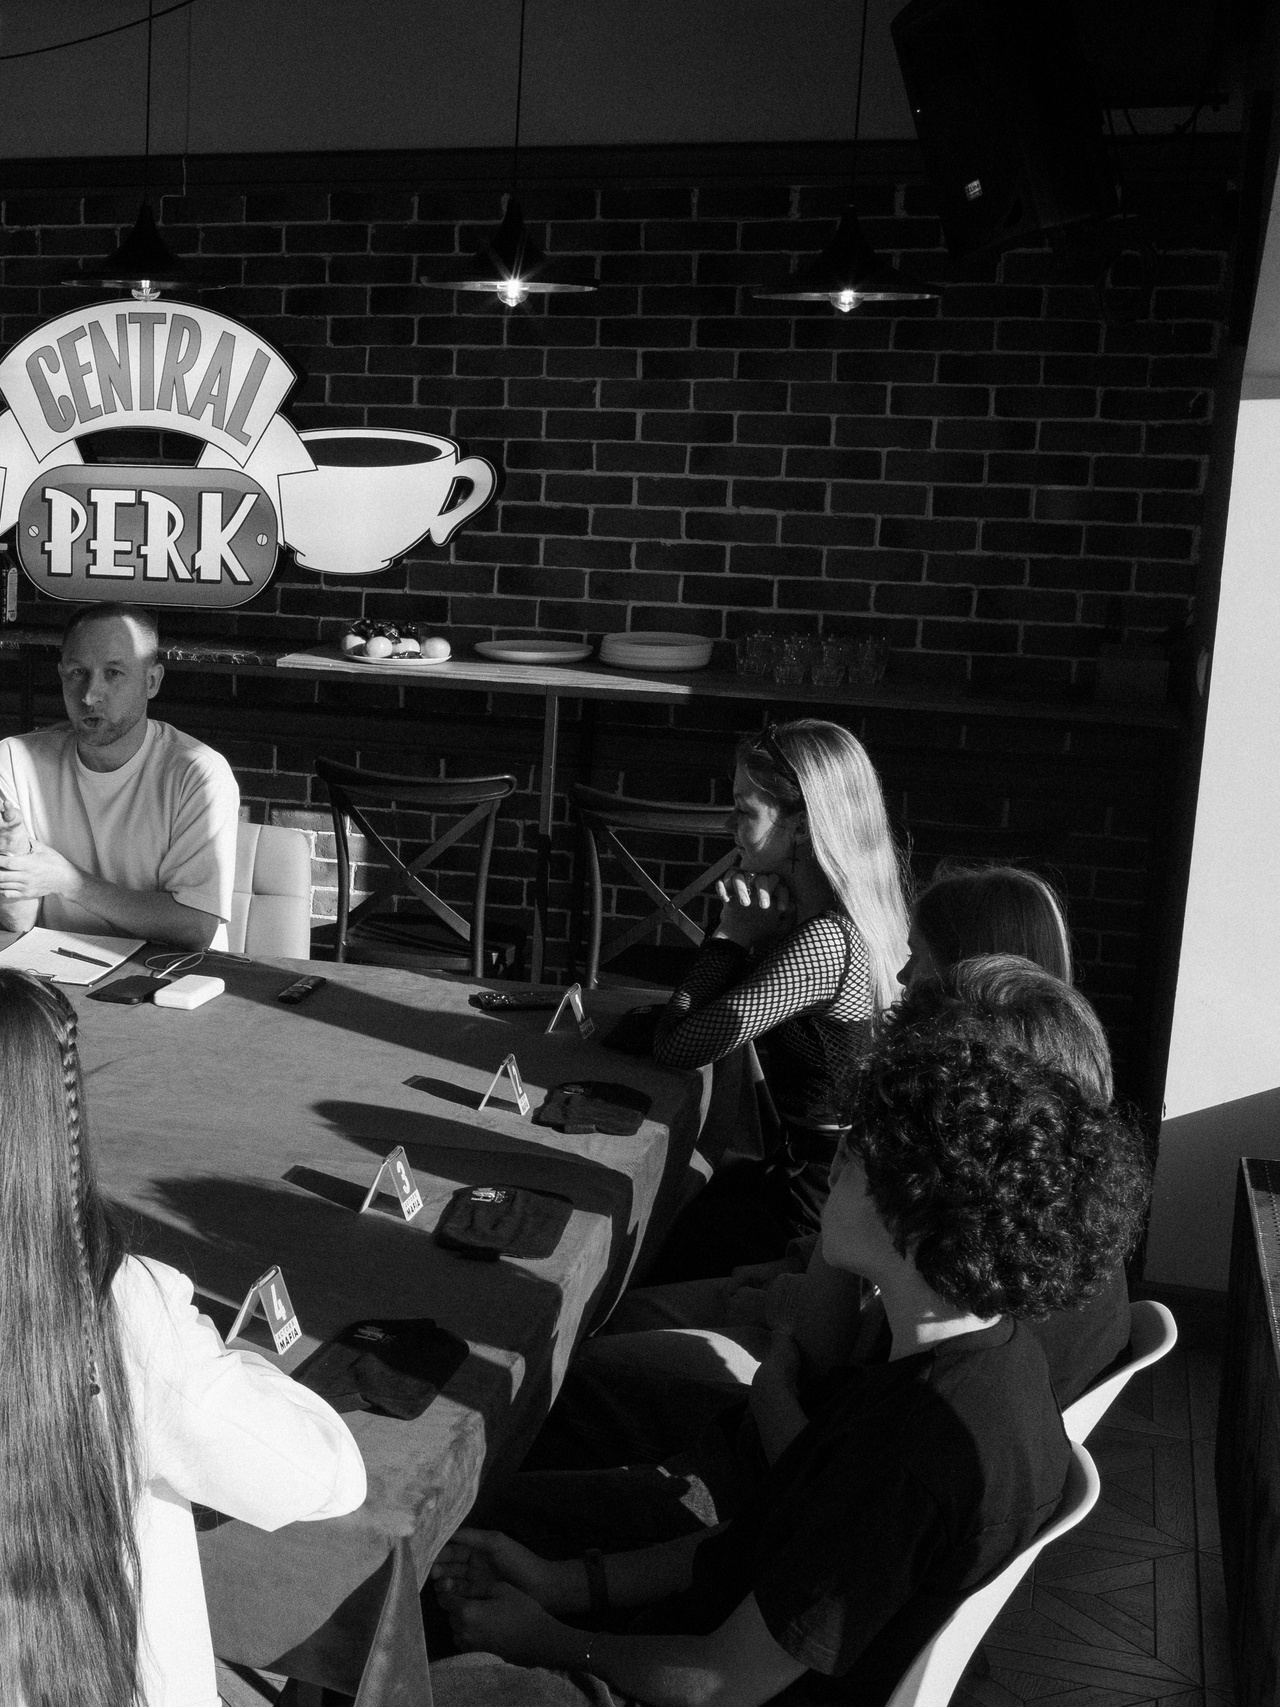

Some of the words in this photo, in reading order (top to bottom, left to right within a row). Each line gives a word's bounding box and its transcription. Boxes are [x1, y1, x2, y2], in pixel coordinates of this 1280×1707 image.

[25, 312, 271, 446] CENTRAL
[42, 486, 261, 585] PERK
[511, 1065, 523, 1095] 2
[396, 1160, 411, 1194] 3
[270, 1283, 288, 1321] 4
[279, 1327, 300, 1351] MAFIA
